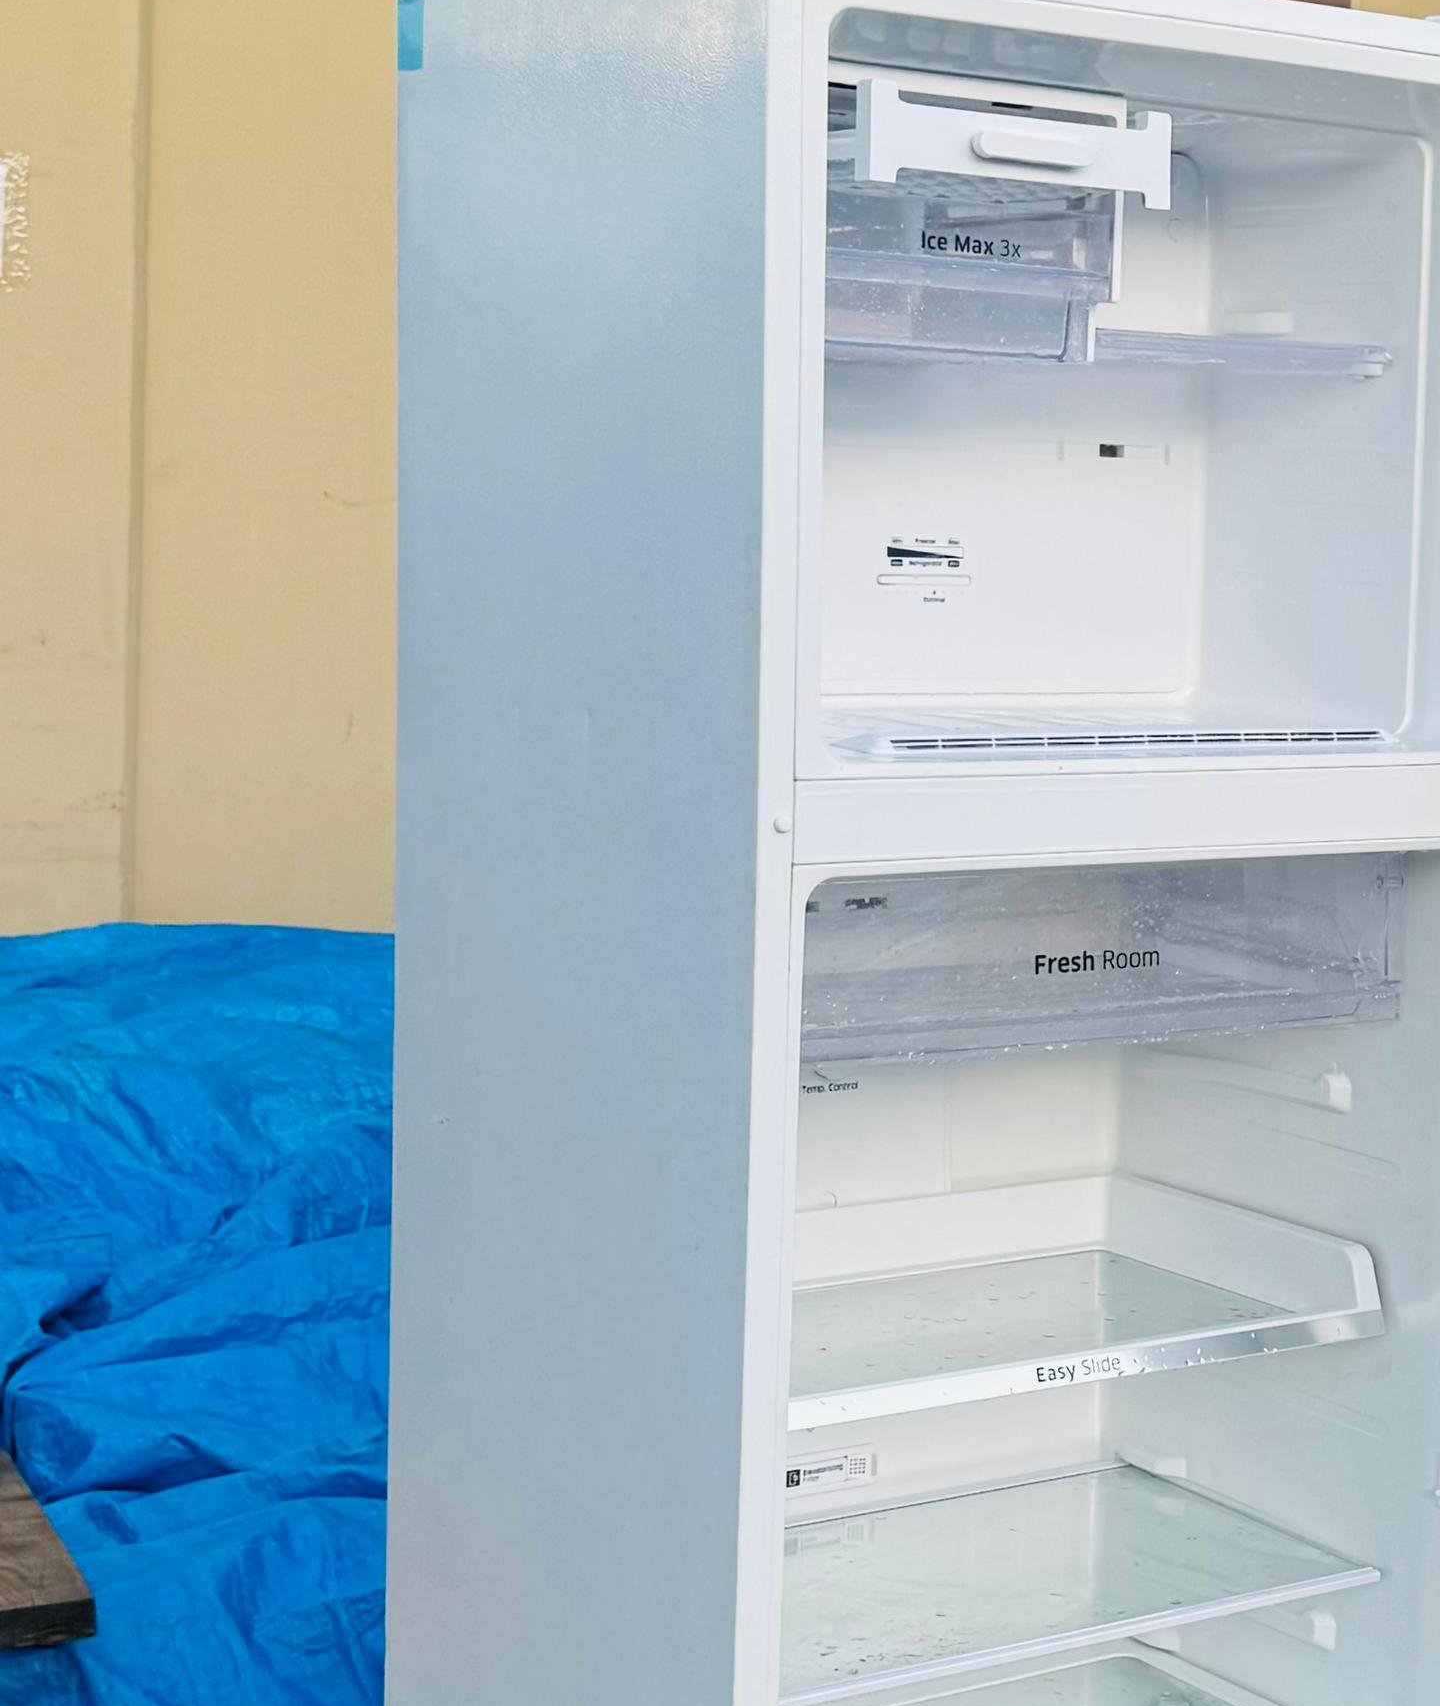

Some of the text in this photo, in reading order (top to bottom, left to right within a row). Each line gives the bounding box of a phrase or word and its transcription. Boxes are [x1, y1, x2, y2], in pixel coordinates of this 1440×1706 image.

[921, 231, 1021, 258] Ice Max 3x
[1034, 950, 1160, 975] Fresh Room
[1036, 1356, 1121, 1382] Easy Slide
